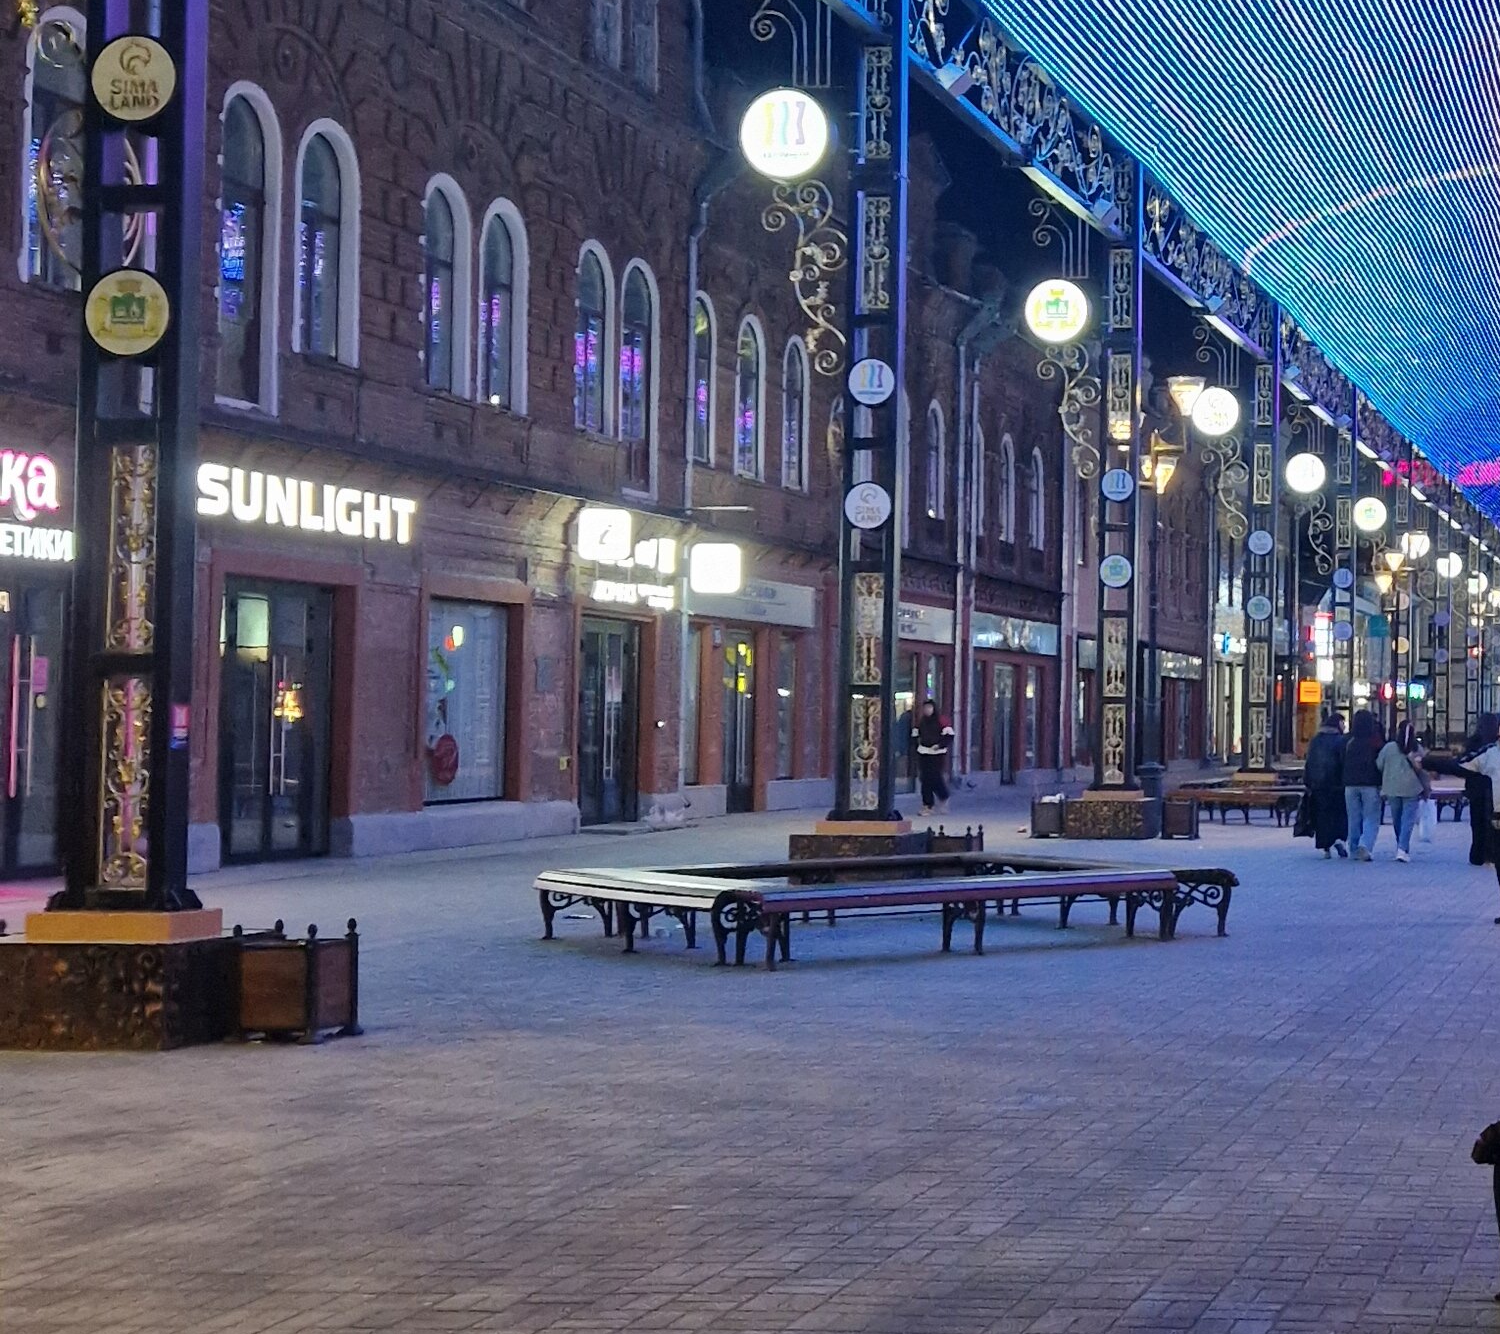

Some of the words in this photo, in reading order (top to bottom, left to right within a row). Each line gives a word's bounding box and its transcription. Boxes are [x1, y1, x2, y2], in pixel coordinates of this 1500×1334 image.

[110, 78, 159, 95] SIMA
[109, 95, 160, 110] LAND
[197, 463, 417, 545] SUNLIGHT
